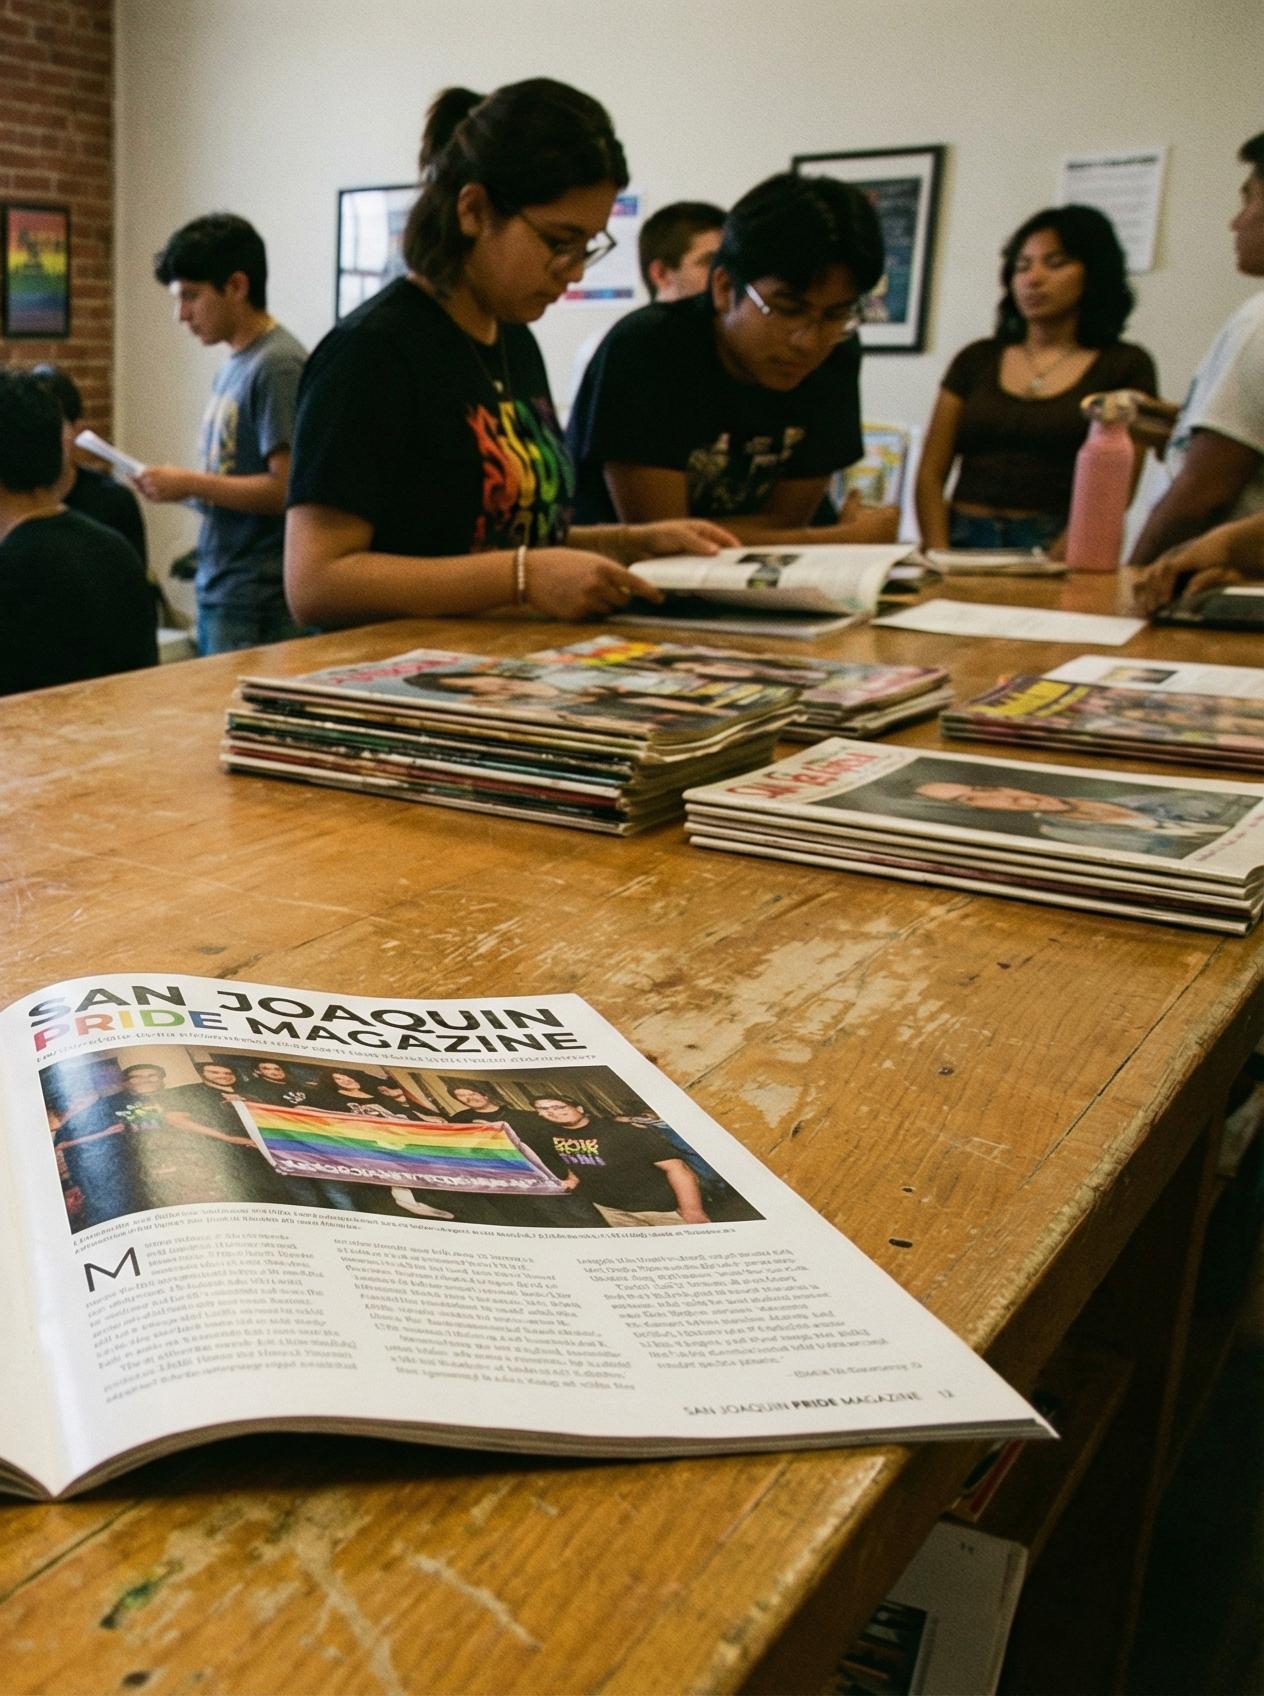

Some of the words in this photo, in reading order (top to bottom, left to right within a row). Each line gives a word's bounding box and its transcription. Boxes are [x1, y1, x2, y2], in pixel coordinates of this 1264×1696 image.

[29, 986, 186, 1027] SAN
[217, 990, 564, 1033] JOAQUIN
[33, 1010, 228, 1052] PRIDE
[245, 1017, 587, 1053] MAGAZINE
[84, 1247, 140, 1293] M
[683, 1405, 716, 1416] SAN
[721, 1401, 789, 1416] JOAQUIN
[792, 1397, 840, 1410] PRIDE
[843, 1391, 923, 1405] MAGAZINE
